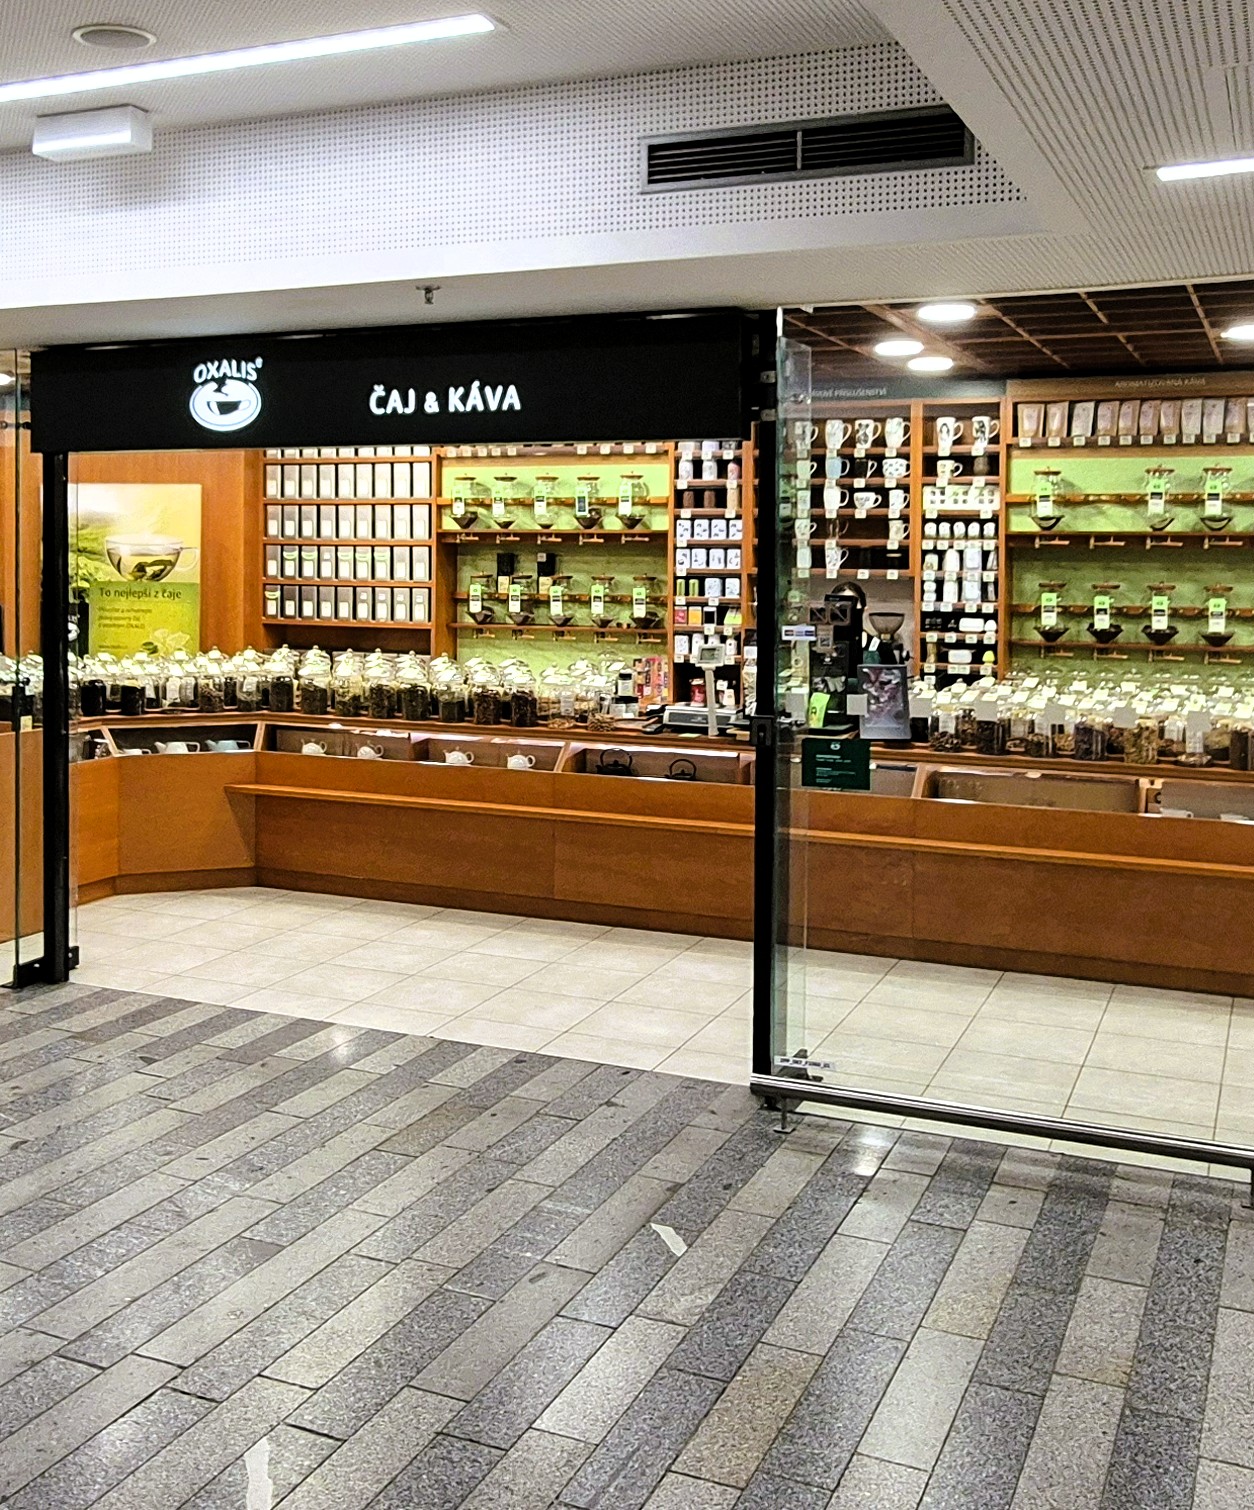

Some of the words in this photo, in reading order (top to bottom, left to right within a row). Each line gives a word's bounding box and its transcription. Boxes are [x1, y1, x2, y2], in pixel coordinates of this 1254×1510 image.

[194, 357, 258, 383] OXALIS
[369, 384, 416, 415] ČAJ
[423, 391, 440, 414] &
[448, 379, 521, 413] KÁVA
[99, 587, 111, 598] To
[114, 587, 151, 600] nejlepší
[161, 588, 182, 600] čaje
